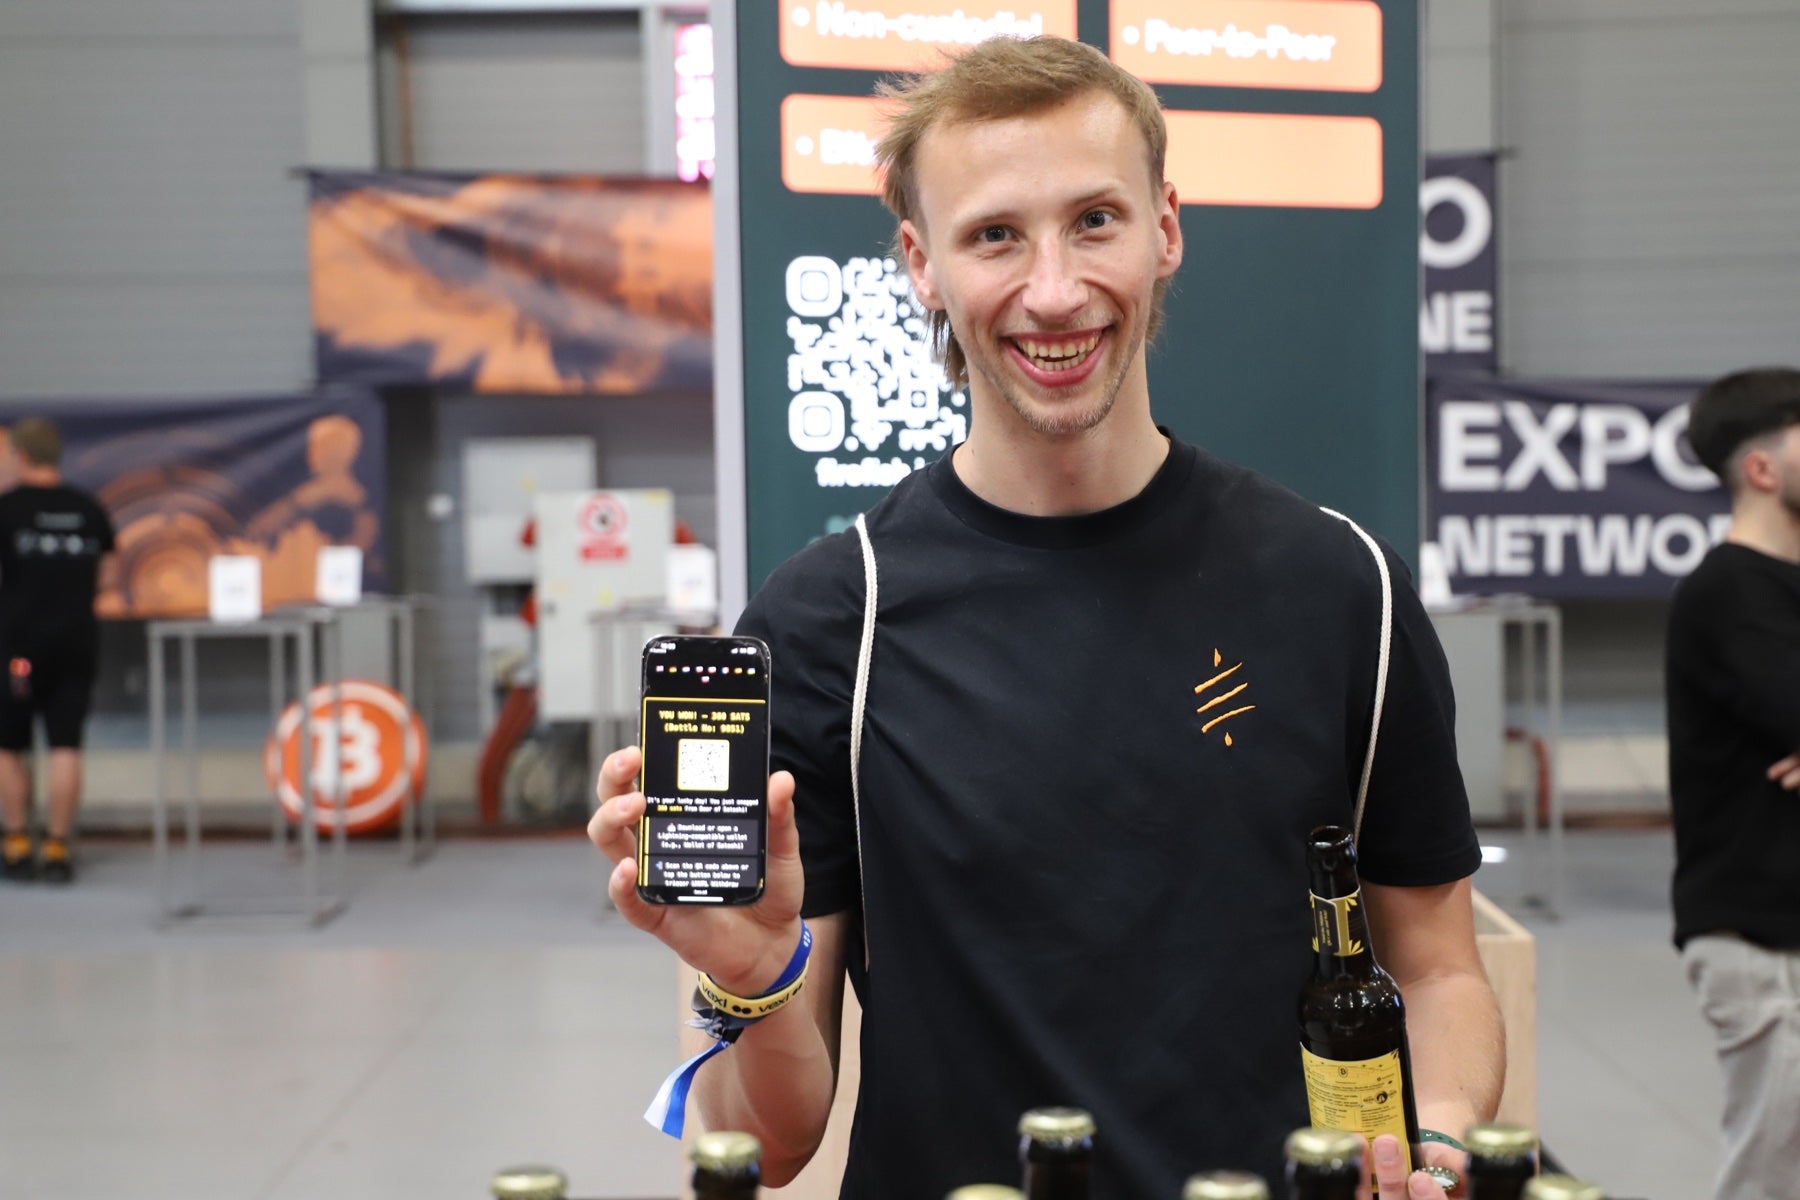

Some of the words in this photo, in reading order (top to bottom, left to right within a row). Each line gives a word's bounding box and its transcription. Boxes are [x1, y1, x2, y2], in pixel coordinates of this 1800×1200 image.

[1145, 19, 1336, 60] Peer-to-Peer
[659, 711, 674, 719] YOU
[678, 711, 697, 719] WON!
[730, 713, 750, 721] SATS
[664, 723, 698, 732] (Bottle
[701, 724, 715, 732] No:
